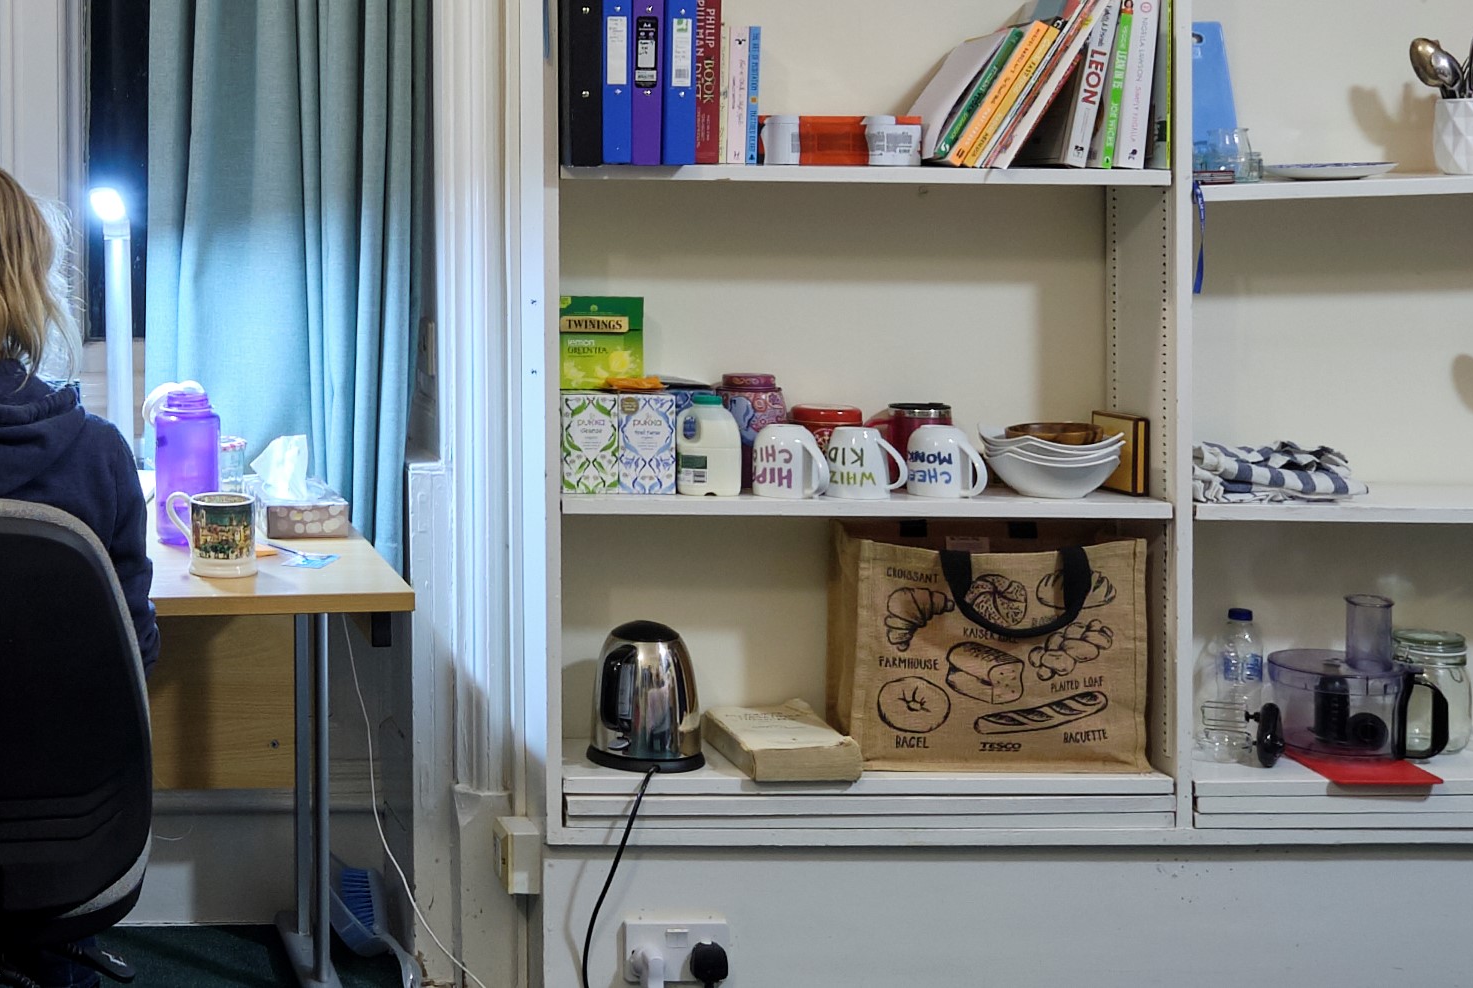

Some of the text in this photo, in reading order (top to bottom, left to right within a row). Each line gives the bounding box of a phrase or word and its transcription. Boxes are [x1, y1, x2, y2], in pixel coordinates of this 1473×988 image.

[705, 8, 716, 49] PHILIP
[1114, 50, 1127, 69] LEAN
[1022, 60, 1036, 77] FAST
[704, 58, 715, 104] BOOK
[1082, 49, 1106, 106] LEON
[1109, 102, 1117, 117] JOE
[1105, 119, 1115, 146] WICKS
[566, 319, 623, 330] TWININGS
[567, 346, 593, 354] GREEN
[577, 419, 606, 427] pukka
[632, 419, 662, 427] pukka
[828, 446, 864, 468] KID
[886, 566, 939, 583] CROISSANT
[877, 655, 940, 671] FARMHOUSE
[1050, 675, 1105, 694] PLAITED LOAF
[895, 735, 930, 749] BAGEL
[1063, 729, 1109, 744] BAGUETTE
[979, 741, 1022, 752] TESCO
